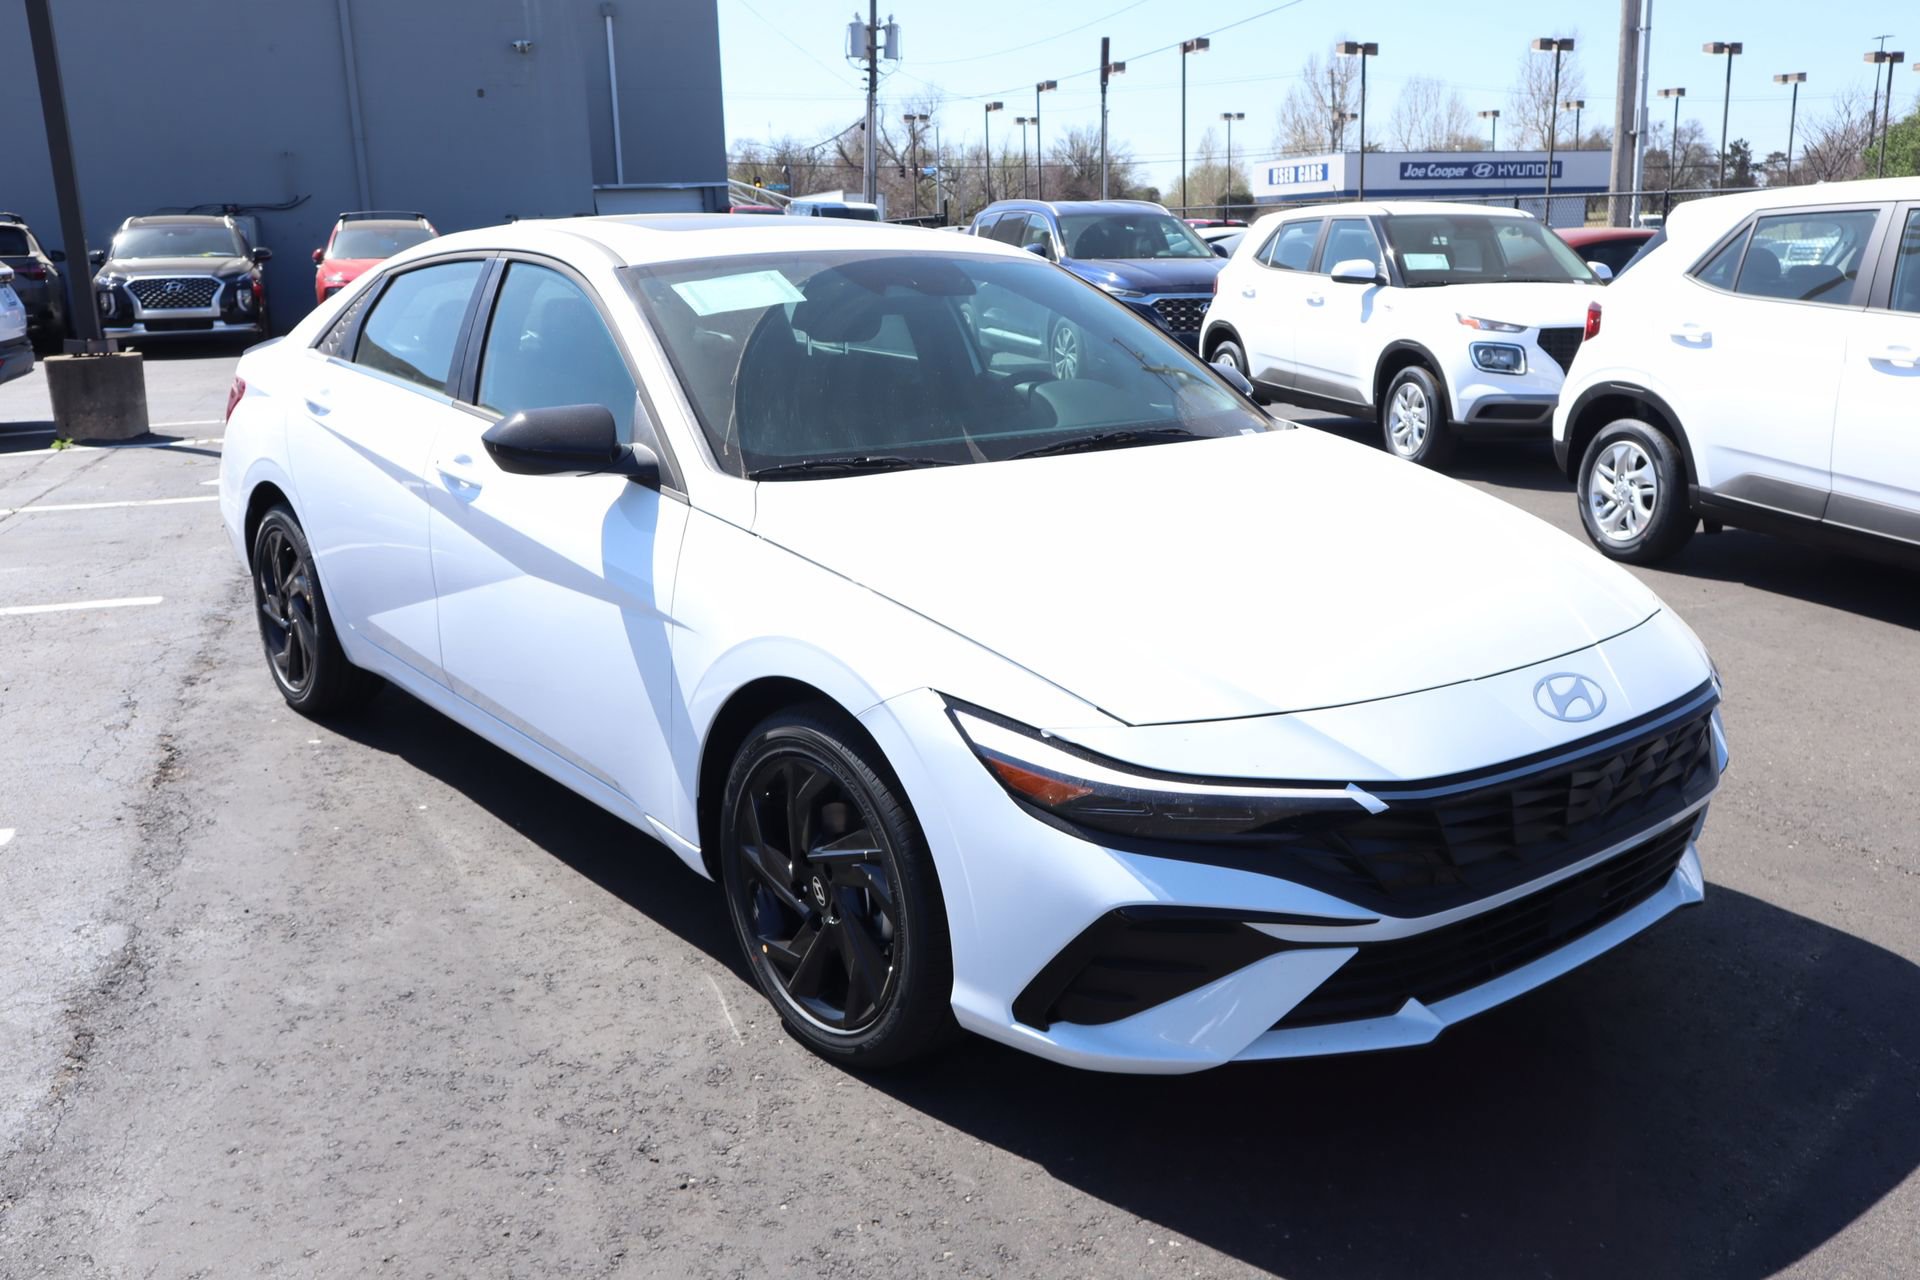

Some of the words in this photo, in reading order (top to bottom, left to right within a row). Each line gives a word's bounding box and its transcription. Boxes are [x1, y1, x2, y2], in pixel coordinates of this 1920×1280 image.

[1273, 166, 1296, 185] USED
[1298, 163, 1323, 183] CARS
[1404, 163, 1426, 177] Joe
[1427, 163, 1468, 179] Cooper
